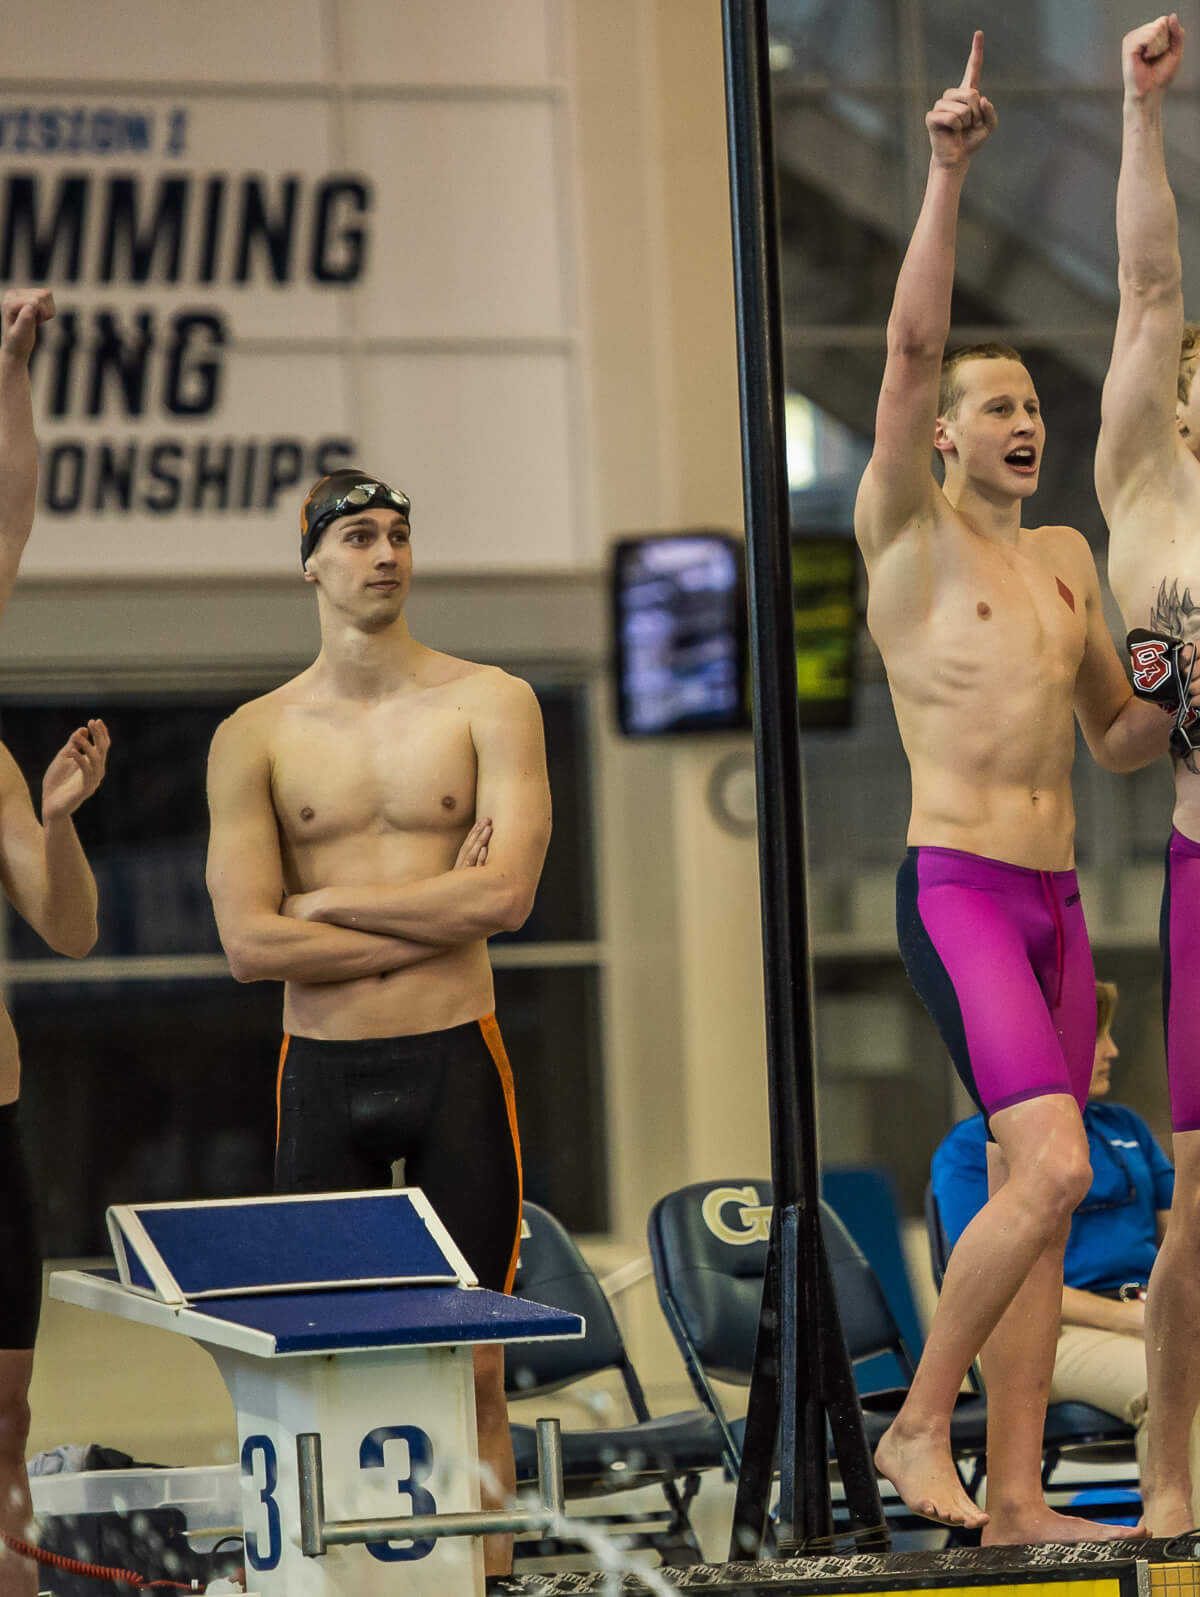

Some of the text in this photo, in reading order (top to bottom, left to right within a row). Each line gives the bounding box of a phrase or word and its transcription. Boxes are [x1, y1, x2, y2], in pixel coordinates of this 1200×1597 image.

[0, 171, 373, 287] MMING
[241, 1434, 282, 1572] 3
[359, 1425, 437, 1562] 3
